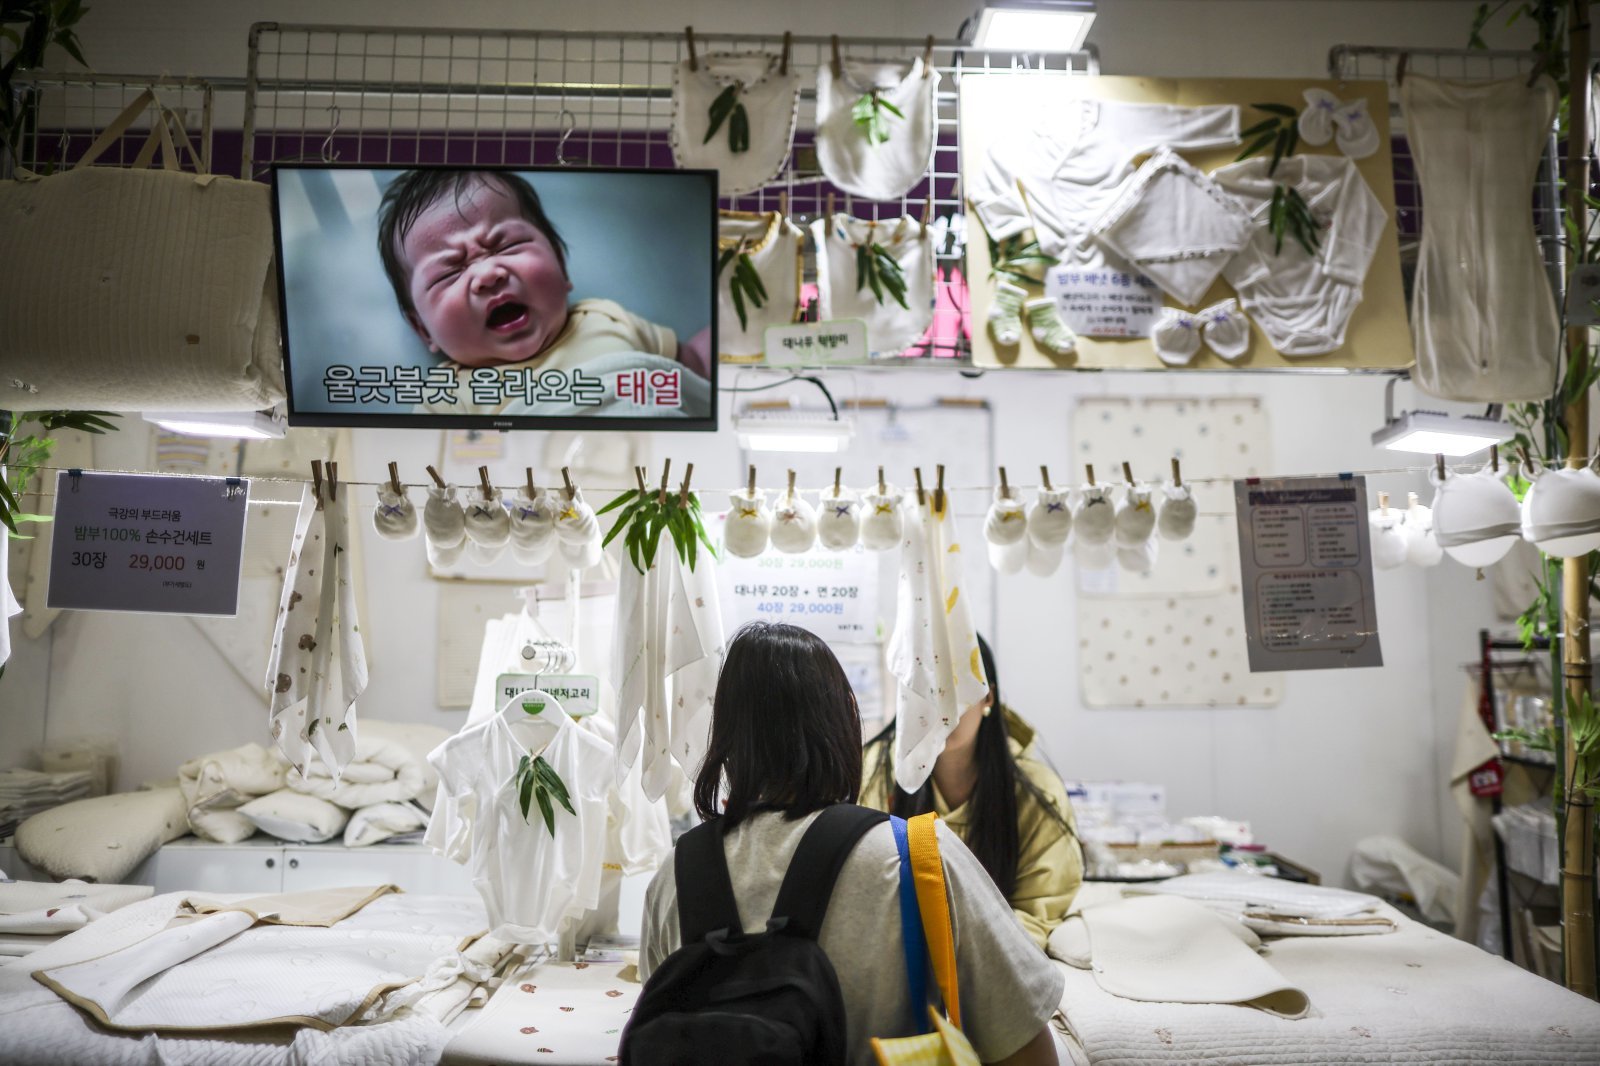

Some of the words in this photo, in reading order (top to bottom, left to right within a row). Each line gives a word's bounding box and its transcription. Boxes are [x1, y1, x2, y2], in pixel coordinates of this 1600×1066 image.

[323, 365, 459, 405] 울긋불긋
[468, 367, 605, 406] 올라오는
[616, 368, 682, 407] 태열
[108, 507, 139, 520] 극강의
[141, 509, 182, 522] 부드러움
[74, 525, 141, 542] 밤부100%
[145, 529, 213, 546] 손수건세트
[71, 551, 108, 569] 30장
[128, 554, 185, 572] 29,000
[196, 559, 206, 570] 원
[757, 558, 783, 569] 30장
[734, 584, 768, 597] 대나무
[772, 585, 799, 598] 20장
[831, 586, 859, 598] 20장
[757, 602, 783, 614] 40장
[789, 602, 844, 615] 29,000원
